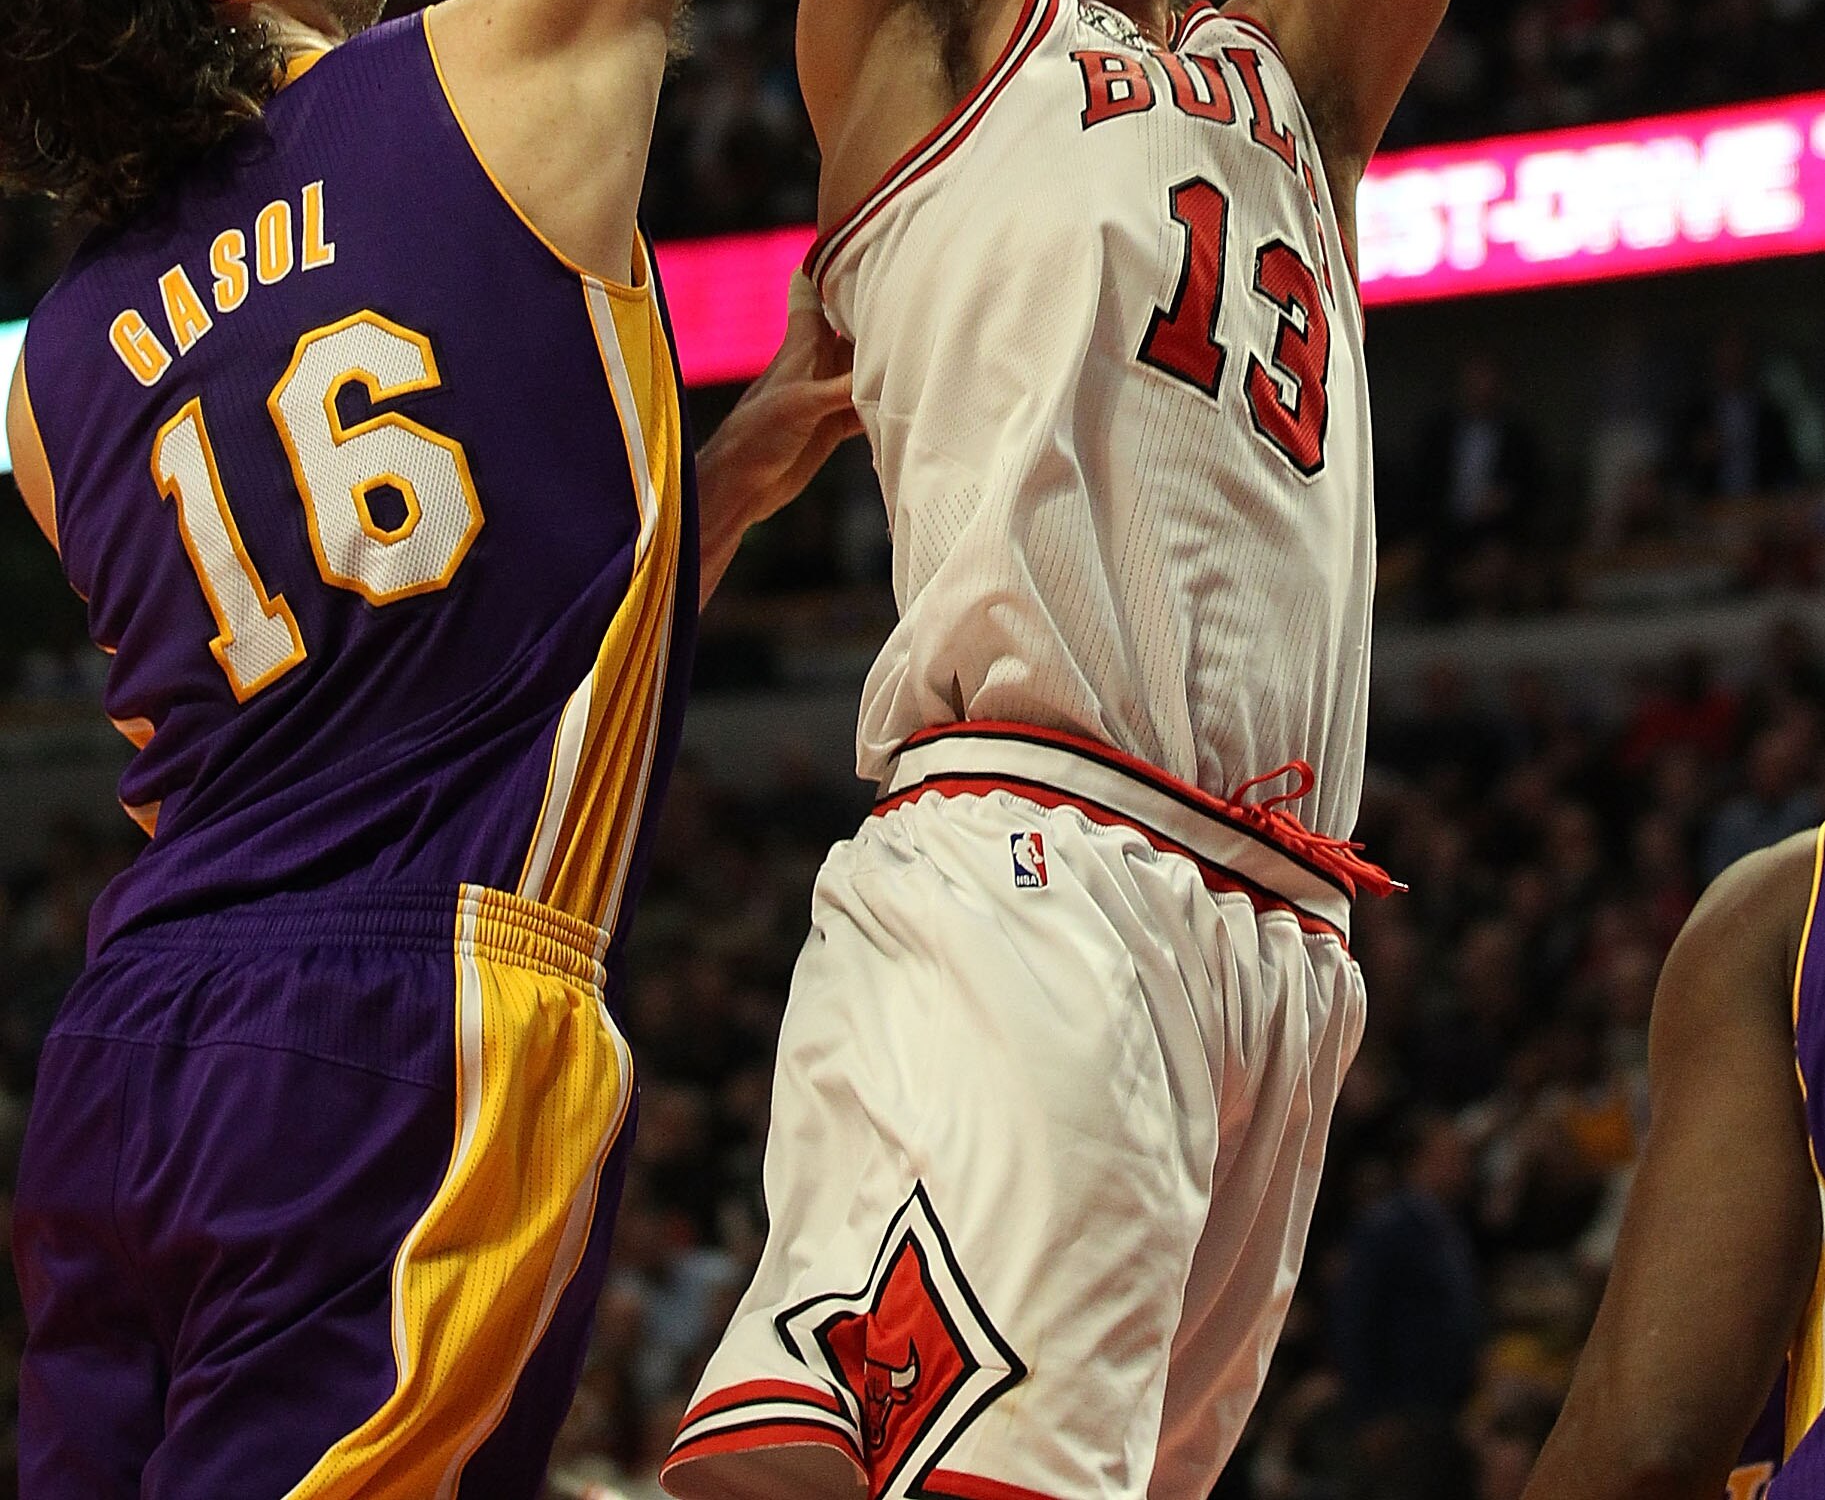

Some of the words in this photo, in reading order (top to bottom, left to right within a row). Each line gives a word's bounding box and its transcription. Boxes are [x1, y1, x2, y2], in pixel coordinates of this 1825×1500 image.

[109, 180, 335, 387] GASOL
[1136, 176, 1333, 477] 13
[151, 309, 485, 703] 16
